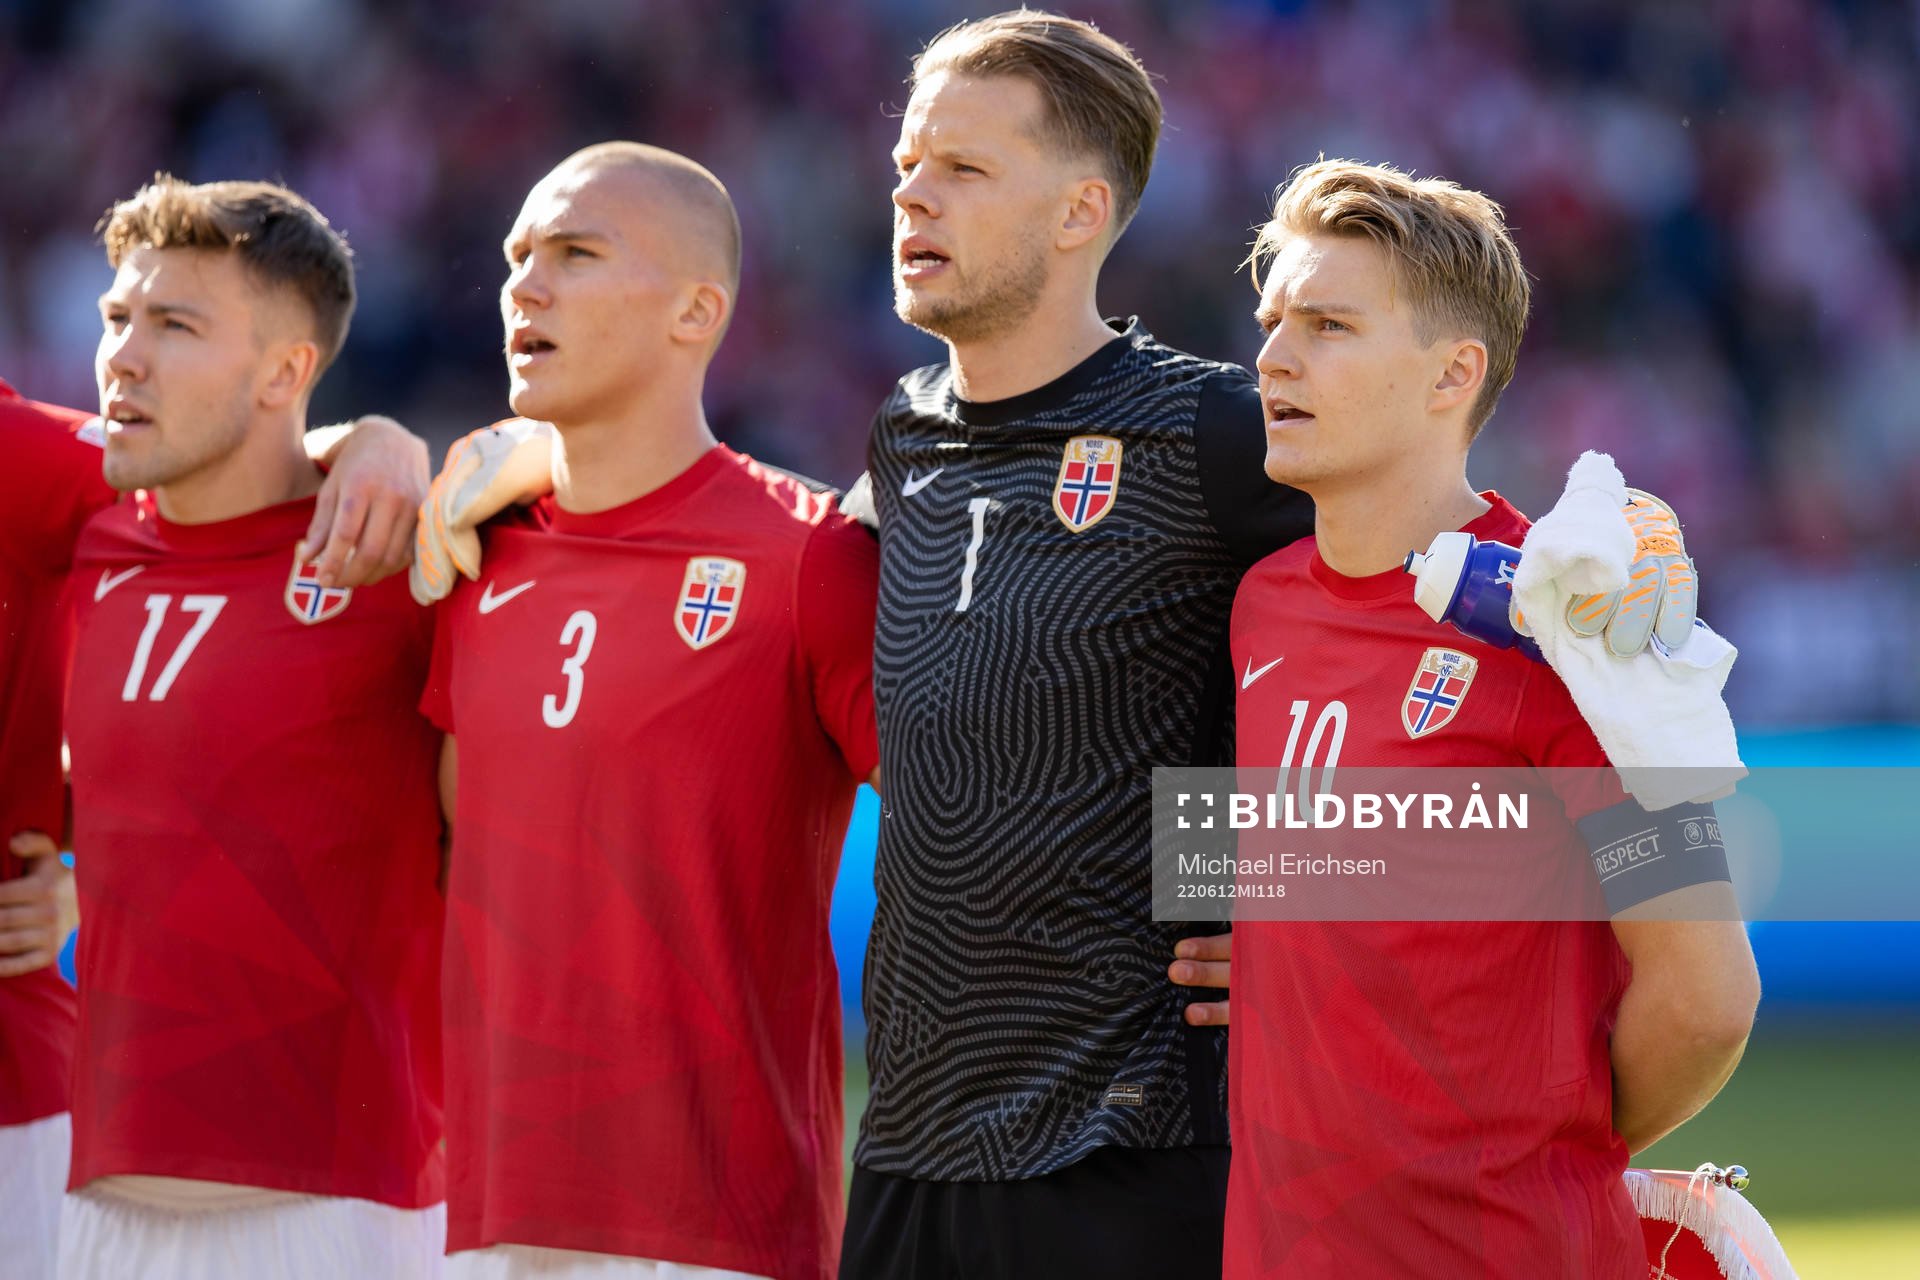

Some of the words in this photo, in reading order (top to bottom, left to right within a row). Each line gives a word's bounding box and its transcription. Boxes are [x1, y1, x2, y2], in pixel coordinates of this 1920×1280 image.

[955, 498, 990, 612] 1
[122, 594, 228, 702] 17
[542, 610, 597, 729] 3
[1442, 652, 1461, 665] NORGE
[1275, 700, 1348, 824] 10
[1596, 834, 1660, 876] RESPECT
